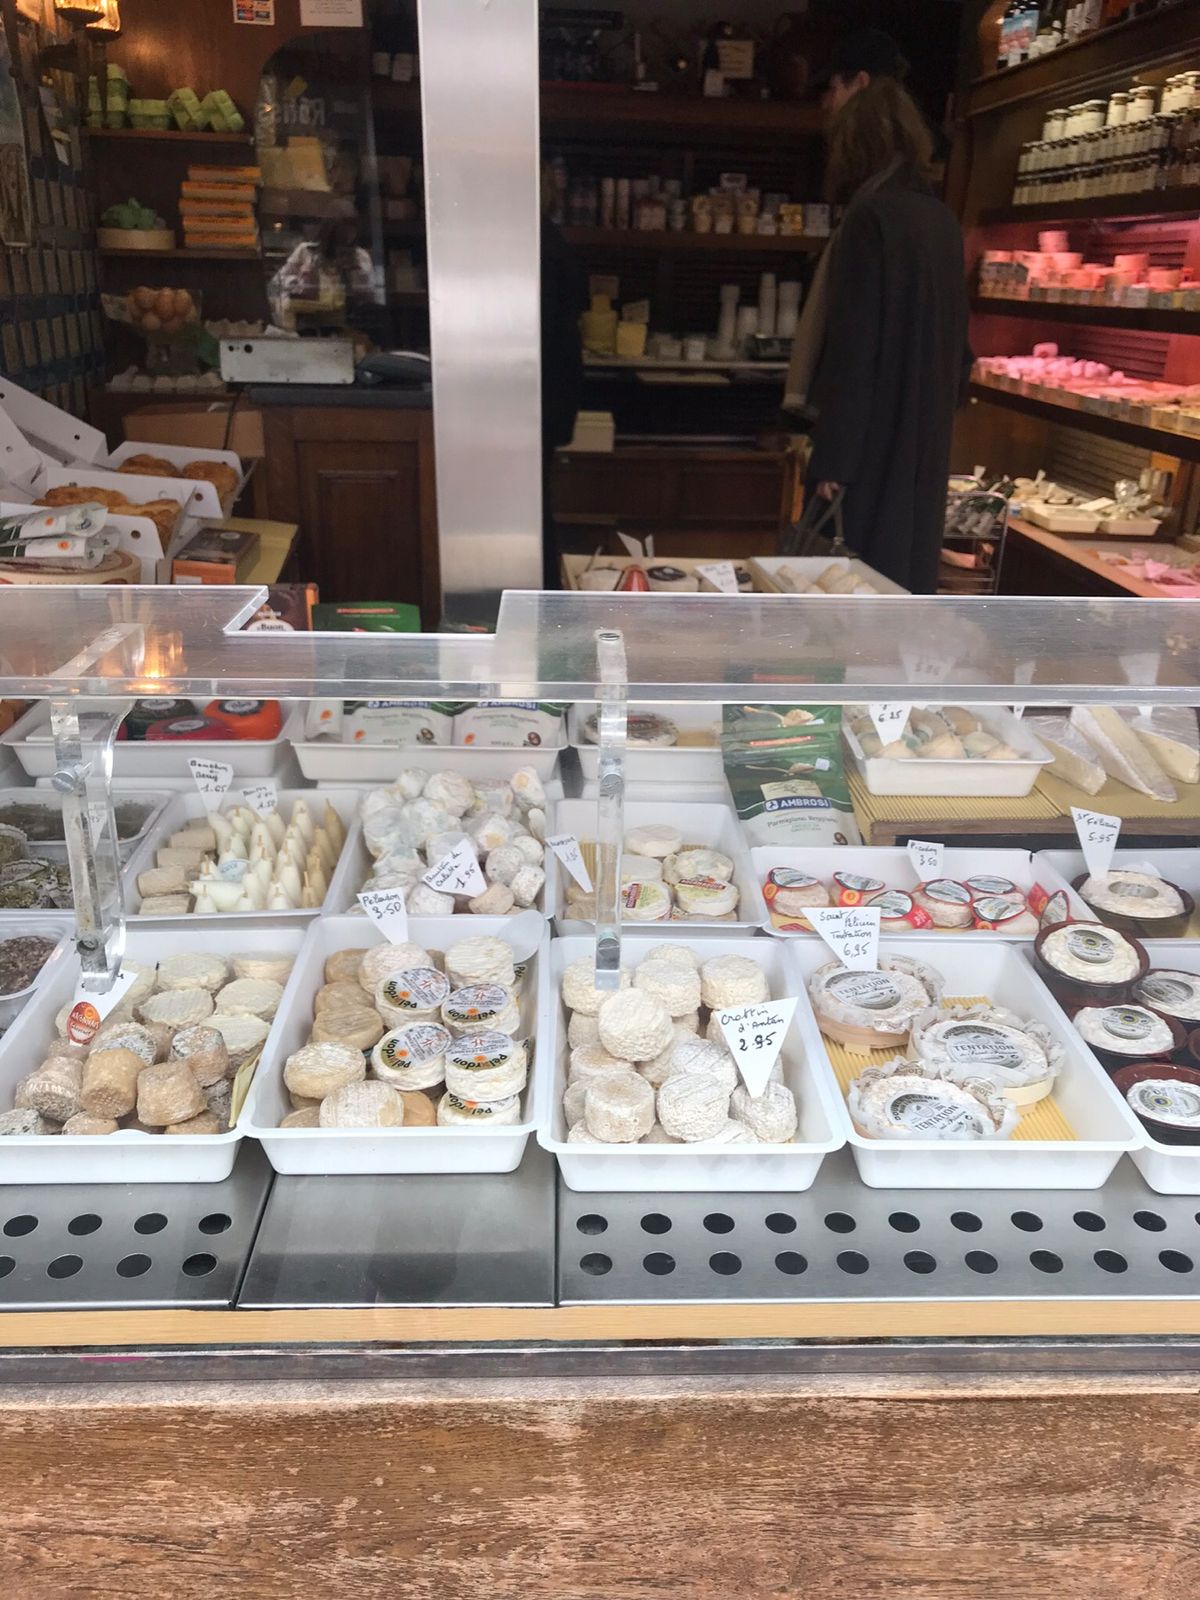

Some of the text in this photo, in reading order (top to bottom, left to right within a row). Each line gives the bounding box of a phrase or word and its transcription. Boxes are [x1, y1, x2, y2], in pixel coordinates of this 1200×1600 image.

[780, 798, 830, 809] AMBROSI
[838, 978, 891, 996] TENTATION
[739, 1031, 777, 1052] 2.95
[953, 1044, 1016, 1052] TENTATION
[914, 1103, 960, 1131] TENTATION
